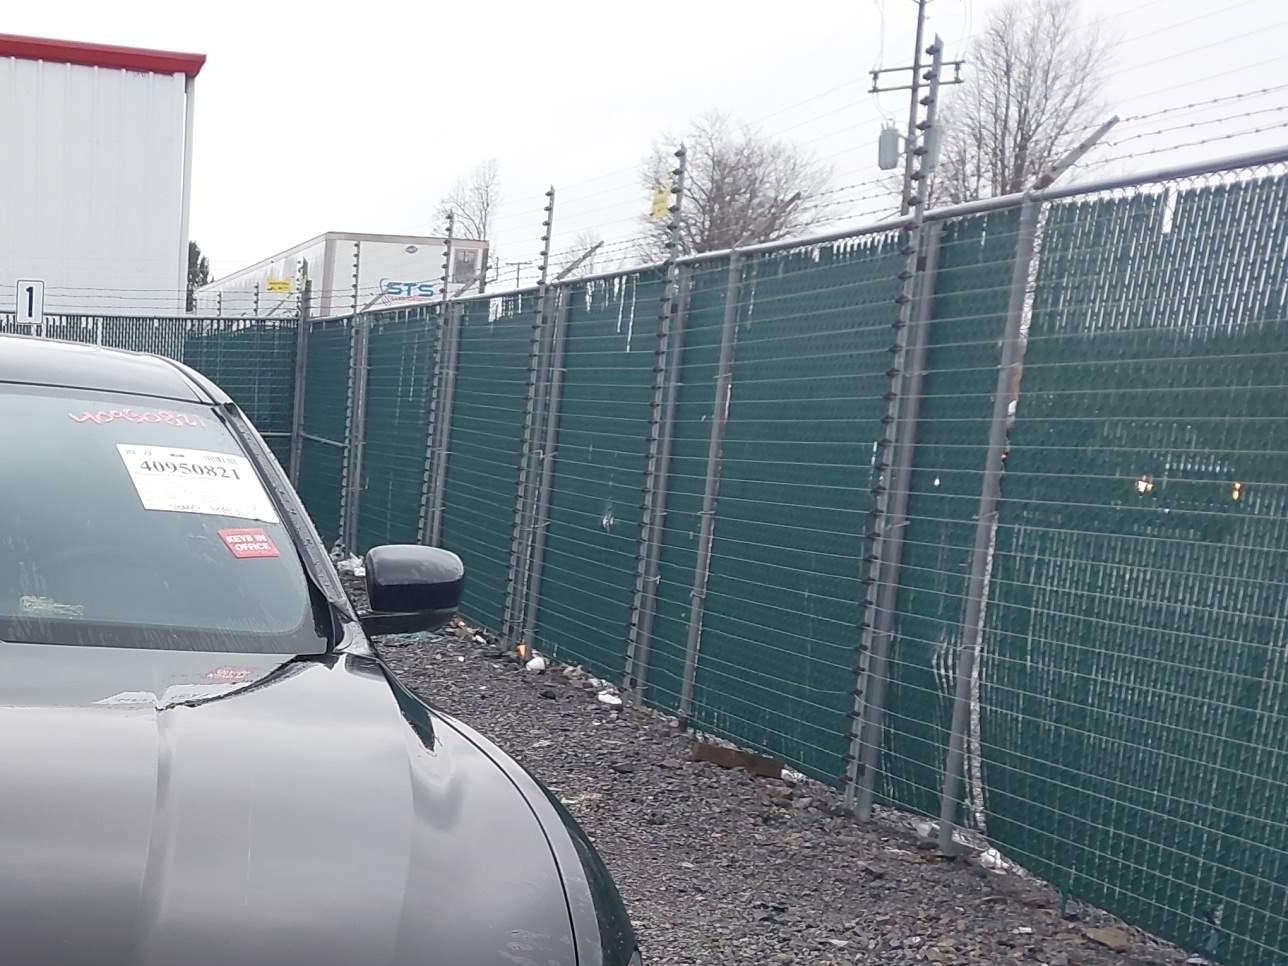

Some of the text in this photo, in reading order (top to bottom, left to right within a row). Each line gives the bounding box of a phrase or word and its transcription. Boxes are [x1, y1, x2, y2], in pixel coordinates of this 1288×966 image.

[385, 281, 434, 297] STS
[25, 286, 35, 318] 1
[140, 460, 241, 481] 40950821
[253, 534, 267, 542] IN
[234, 542, 272, 551] OFFICE
